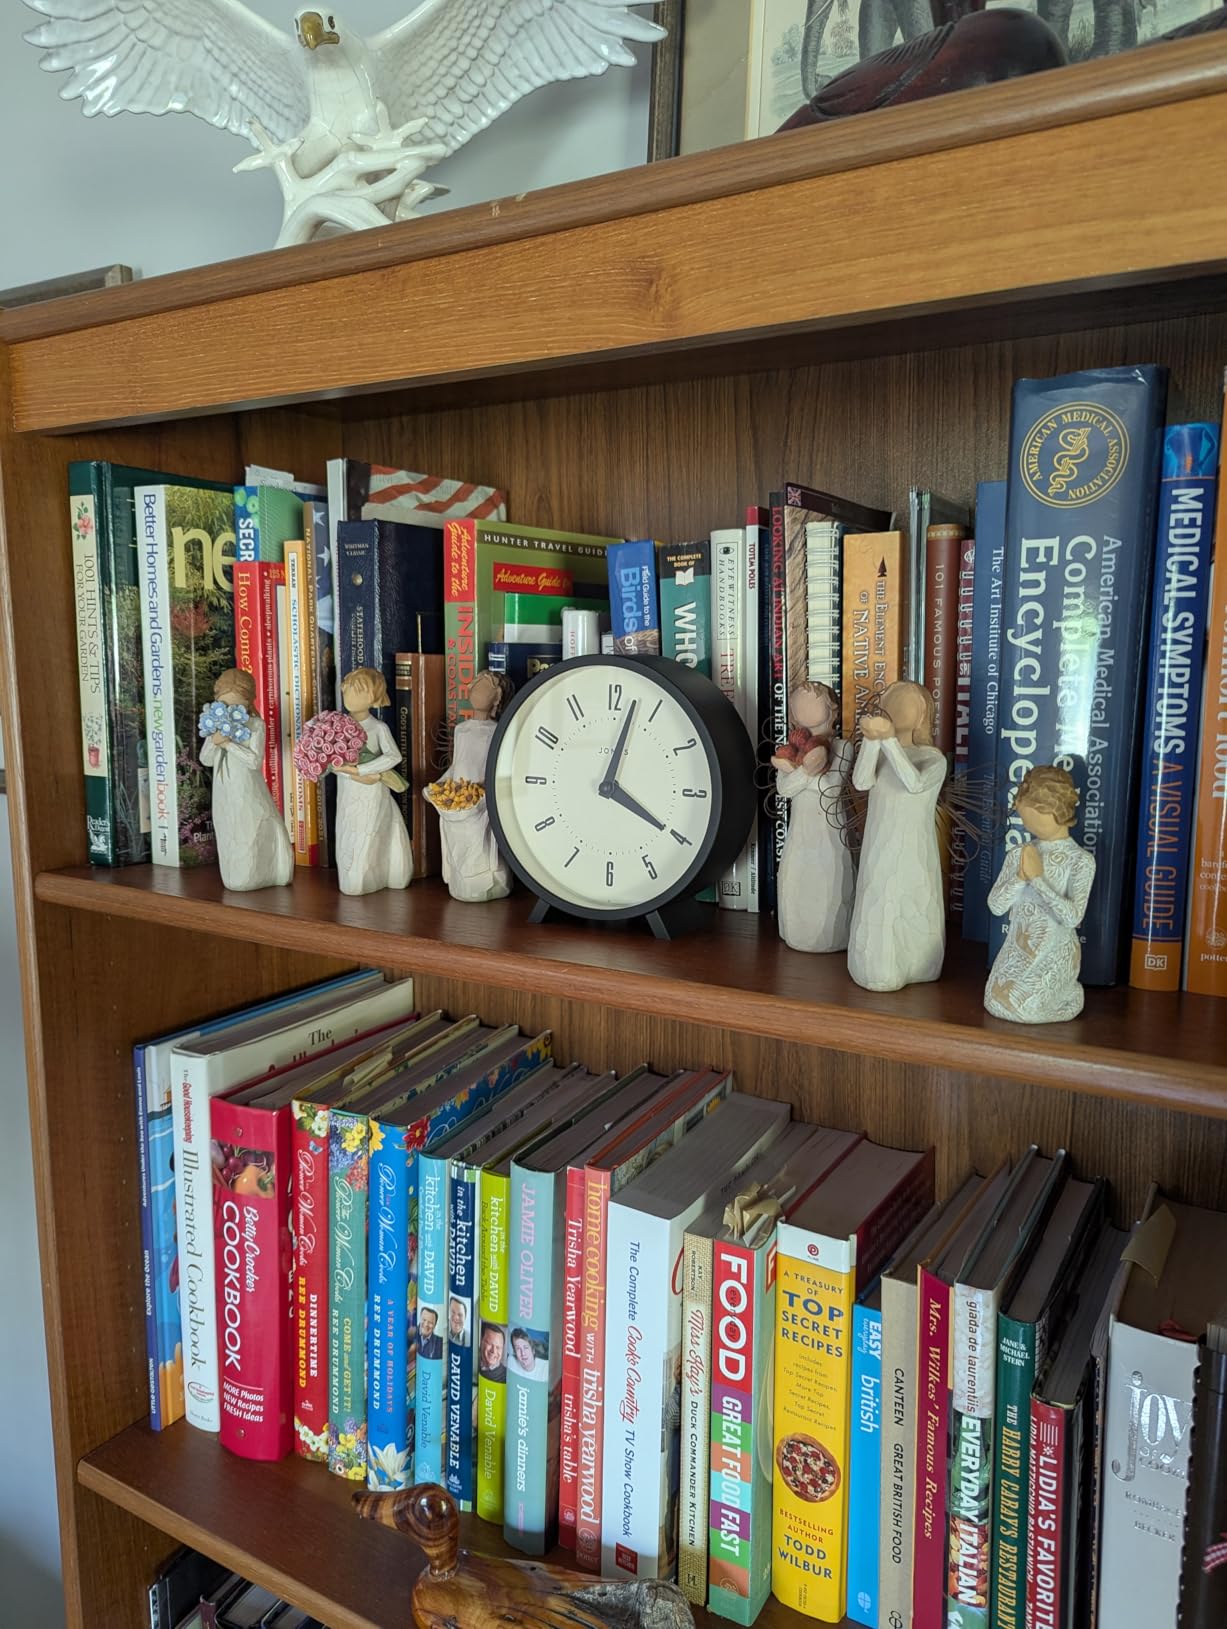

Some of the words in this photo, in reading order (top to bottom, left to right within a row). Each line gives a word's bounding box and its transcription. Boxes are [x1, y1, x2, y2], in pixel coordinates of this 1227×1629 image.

[1062, 411, 1111, 437] MEDICAL
[1027, 420, 1058, 481] AMERICAN
[1068, 438, 1119, 499] ASSOCIATION
[144, 494, 159, 542] Better
[239, 517, 255, 562] SECR
[448, 521, 462, 560] Guide
[772, 506, 784, 574] LOOKING
[461, 526, 472, 592] Adventure
[483, 532, 529, 547] HUNTER
[534, 540, 574, 554] TRAVEL
[666, 553, 677, 562] THE
[677, 552, 702, 561] COMPLETE
[749, 543, 757, 567] TOTEM
[992, 546, 1005, 574] The
[1164, 488, 1204, 605] MEDICAL
[84, 554, 96, 587] 1001
[146, 543, 160, 600] Homes
[496, 569, 537, 585] Adventure
[748, 569, 756, 590] POLES
[876, 581, 886, 599] THE
[935, 564, 945, 590] 101
[991, 577, 1003, 600] Art
[1099, 534, 1122, 639] American
[86, 589, 98, 639] HINTS
[238, 573, 251, 614] How
[621, 566, 642, 637] Birds
[718, 559, 726, 637] HANDBOOKS
[726, 558, 736, 637] EYEWITNESS
[859, 591, 870, 604] OF
[875, 603, 888, 657] ELEMENT
[933, 597, 944, 669] FAMOUS
[988, 603, 1003, 660] Institute
[1053, 534, 1098, 709] Complete
[240, 616, 253, 673] Come?
[457, 606, 474, 700] INSIDE
[854, 610, 870, 680] NATIVE
[89, 660, 101, 694] TIPS
[987, 661, 998, 679] of
[1090, 648, 1115, 729] Medical
[1154, 612, 1195, 754] SYMPTOMS
[566, 694, 585, 722] 11
[607, 684, 623, 711] 12
[648, 699, 663, 723] 1
[932, 676, 942, 738] POEMS
[982, 680, 999, 736] Chicago
[1000, 535, 1060, 852] Encyclopeia
[534, 725, 559, 751] 10
[774, 703, 786, 731] THE
[673, 738, 697, 756] 2
[1152, 761, 1184, 778] A
[525, 775, 547, 785] 9
[682, 788, 707, 799] 3
[1082, 736, 1110, 856] Association
[534, 816, 556, 832] 8
[669, 829, 693, 846] 4
[1147, 783, 1183, 856] VISUAL
[564, 846, 580, 868] 7
[606, 861, 613, 887] 6
[641, 854, 658, 880] 5
[1143, 867, 1176, 929] GUIDE
[1147, 957, 1165, 969] DK
[307, 1028, 333, 1046] The
[182, 1098, 194, 1143] Housekeeping
[183, 1150, 202, 1257] Illustrated
[241, 1206, 260, 1241] Betty
[456, 1197, 466, 1217] the
[520, 1183, 536, 1247] JAMIE
[585, 1180, 607, 1243] home
[456, 1220, 472, 1286] kitchen
[566, 1218, 583, 1267] Trisha
[628, 1241, 640, 1263] The
[222, 1200, 241, 1373] COOKBOOK
[244, 1241, 260, 1292] Crocker
[423, 1250, 435, 1295] DAVID
[519, 1250, 535, 1321] OLIVER
[581, 1247, 604, 1331] cooking
[793, 1272, 844, 1295] TREASURY
[298, 1276, 306, 1307] REE
[373, 1294, 381, 1323] REE
[564, 1269, 582, 1359] Yearwood
[626, 1264, 641, 1322] Complete
[782, 1289, 844, 1322] TOP
[806, 1286, 819, 1297] OF
[187, 1263, 207, 1370] Cookbook
[309, 1293, 318, 1378] DINNERTIME
[687, 1308, 705, 1348] Miss
[718, 1252, 748, 1382] FOOD
[782, 1310, 843, 1340] SECRET
[928, 1297, 942, 1337] Mrs.
[966, 1301, 978, 1335] giada
[298, 1309, 307, 1388] DRUMMOND
[586, 1332, 596, 1365] WITH
[625, 1325, 643, 1367] Cook's
[781, 1327, 843, 1358] RECIPES
[869, 1320, 882, 1361] EASY
[967, 1336, 978, 1352] de
[1000, 1343, 1031, 1360] MICHAEL
[1002, 1337, 1019, 1348] JANE
[1002, 1353, 1025, 1367] STERN
[373, 1328, 381, 1409] DRUMMOND
[421, 1371, 431, 1407] David
[449, 1352, 461, 1401] DAVID
[684, 1348, 704, 1396] Kay's
[966, 1353, 979, 1413] laurentiis
[223, 1381, 239, 1396] MORE
[240, 1388, 264, 1402] Photos
[223, 1392, 238, 1406] NEW
[238, 1398, 264, 1412] Recipes
[223, 1402, 243, 1417] FRESH
[243, 1409, 264, 1422] Ideas
[484, 1388, 496, 1428] David
[516, 1384, 530, 1438] jamie's
[582, 1368, 603, 1425] trisha
[619, 1367, 642, 1425] Country
[860, 1373, 880, 1433] british
[893, 1367, 905, 1427] CANTEEN
[420, 1408, 431, 1449] Venable
[448, 1403, 461, 1470] VENABLE
[563, 1394, 577, 1443] trisha's
[624, 1429, 636, 1447] TV
[689, 1400, 698, 1431] DUCK
[721, 1395, 742, 1457] GREAT
[484, 1430, 497, 1480] Venable
[563, 1445, 578, 1484] table
[623, 1448, 636, 1481] Show
[893, 1442, 904, 1481] GREAT
[925, 1410, 940, 1474] Famous
[1001, 1426, 1021, 1478] HARRY
[516, 1440, 529, 1493] dinners
[577, 1424, 600, 1525] yearwood
[688, 1433, 698, 1500] COMMANDER
[720, 1457, 741, 1505] FOOD
[958, 1415, 981, 1526] EVERYDAY
[621, 1482, 635, 1539] Cookbook
[892, 1483, 903, 1529] BRITISH
[922, 1477, 938, 1540] Recipes
[1037, 1455, 1059, 1530] LIDIA'S
[687, 1501, 697, 1547] KITCHEN
[719, 1508, 740, 1557] FAST
[779, 1507, 834, 1536] BESTSELLING
[787, 1524, 824, 1544] AUTHOR
[777, 1546, 833, 1580] WILBUR
[783, 1534, 827, 1560] TODD
[891, 1532, 902, 1564] FOOD
[957, 1523, 980, 1604] ITALIAN
